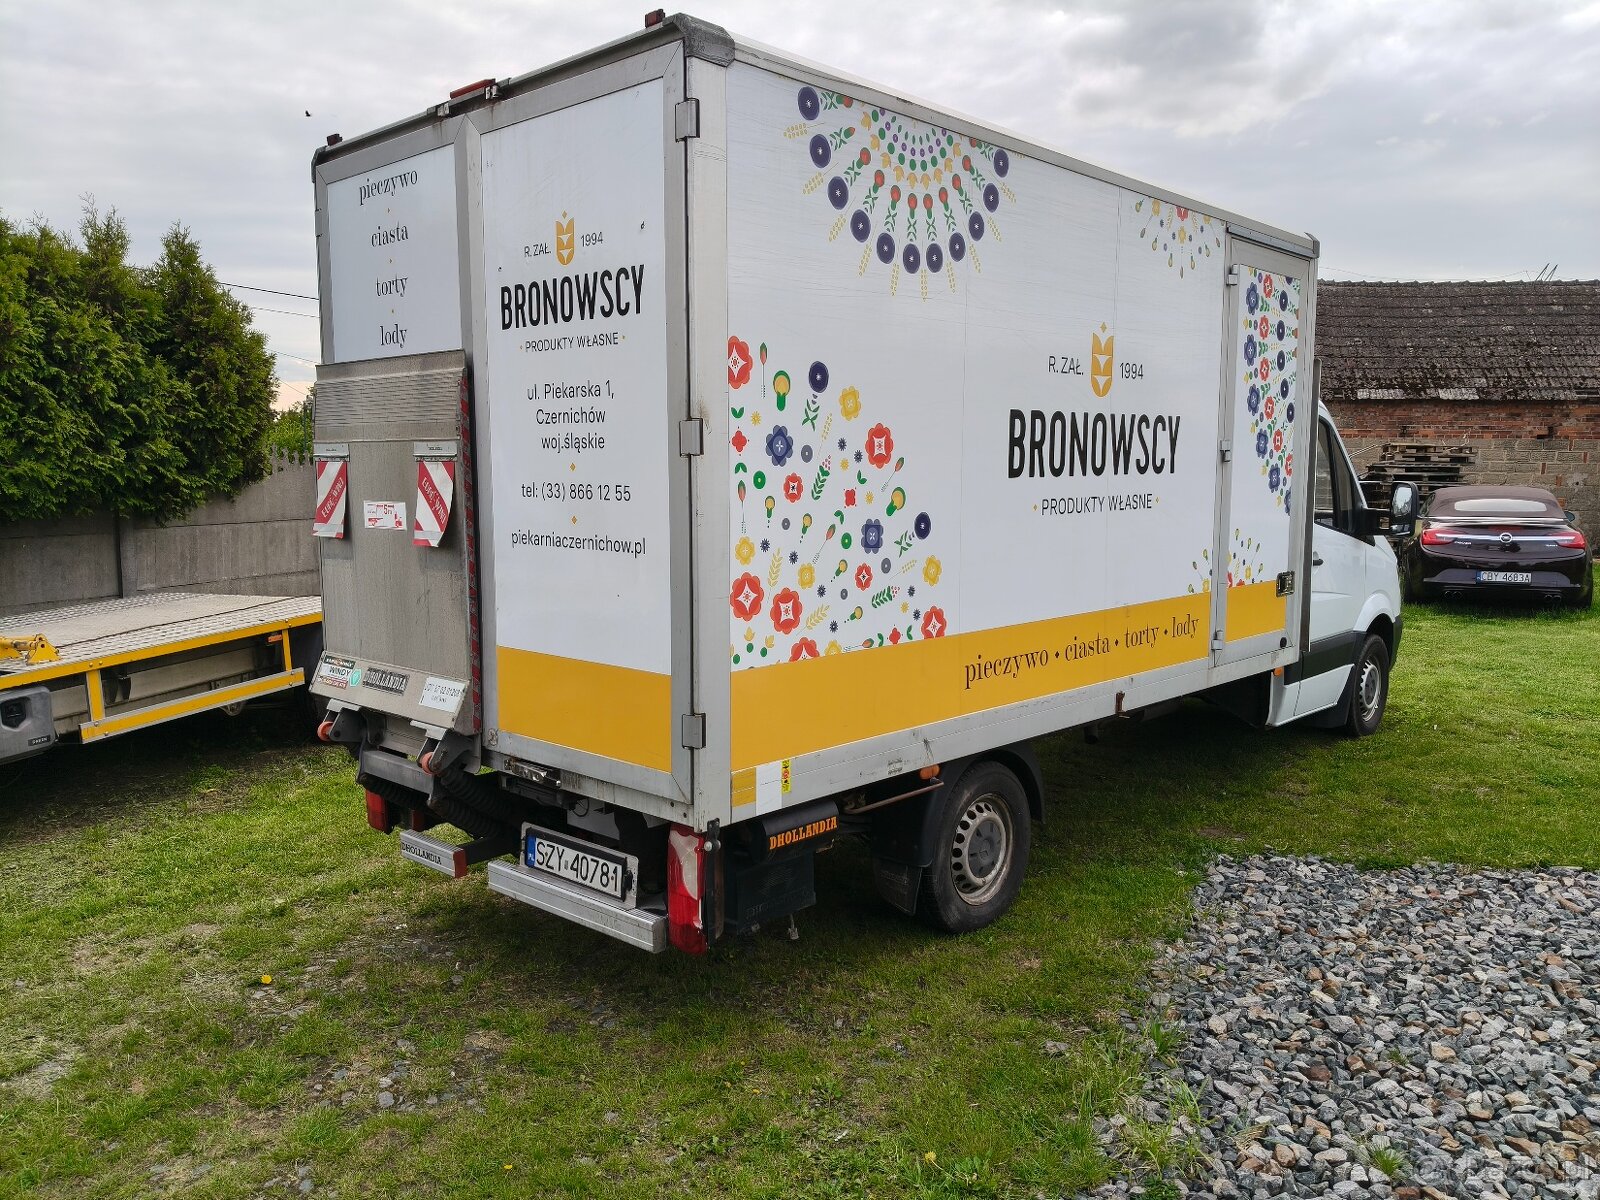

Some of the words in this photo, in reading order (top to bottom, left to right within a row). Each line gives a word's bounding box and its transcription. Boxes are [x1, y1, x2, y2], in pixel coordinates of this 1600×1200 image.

[359, 168, 418, 205] pieczywo
[371, 222, 409, 248] ciasta
[581, 231, 604, 248] 1994
[524, 247, 532, 258] R.
[533, 242, 552, 257] ZAŁ.
[376, 274, 408, 298] torty
[501, 264, 645, 330] BRONOWSCY
[380, 324, 407, 349] lody
[525, 337, 574, 353] PRODUKTY
[576, 332, 619, 349] WŁASNE
[1049, 355, 1059, 373] R.
[1061, 357, 1084, 375] ZAŁ.
[1120, 362, 1144, 379] 1994
[527, 384, 540, 400] ul.
[544, 380, 601, 399] Piekarska
[605, 379, 615, 399] 1,
[536, 406, 606, 424] Czernichów
[541, 432, 605, 453] woj.śląskie
[1008, 409, 1181, 478] BRONOWSCY
[521, 482, 538, 498] tel:
[541, 481, 566, 502] (33)
[569, 484, 593, 500] 866
[597, 485, 611, 501] 12
[615, 486, 631, 502] 55
[1041, 497, 1105, 516] PRODUKTY
[1108, 494, 1153, 511] WŁASNE
[511, 529, 646, 559] piekarniaczernichow.pl
[1481, 572, 1499, 581] CBY
[964, 649, 1049, 689] pieczywo
[1065, 636, 1110, 662] ciasta
[1125, 625, 1160, 648] torty
[1172, 613, 1200, 639] lody
[769, 816, 838, 851] DHOLLANDIA
[402, 842, 442, 866] DHOLLANDIA
[536, 842, 565, 872] SZY
[570, 853, 618, 892] 40781
